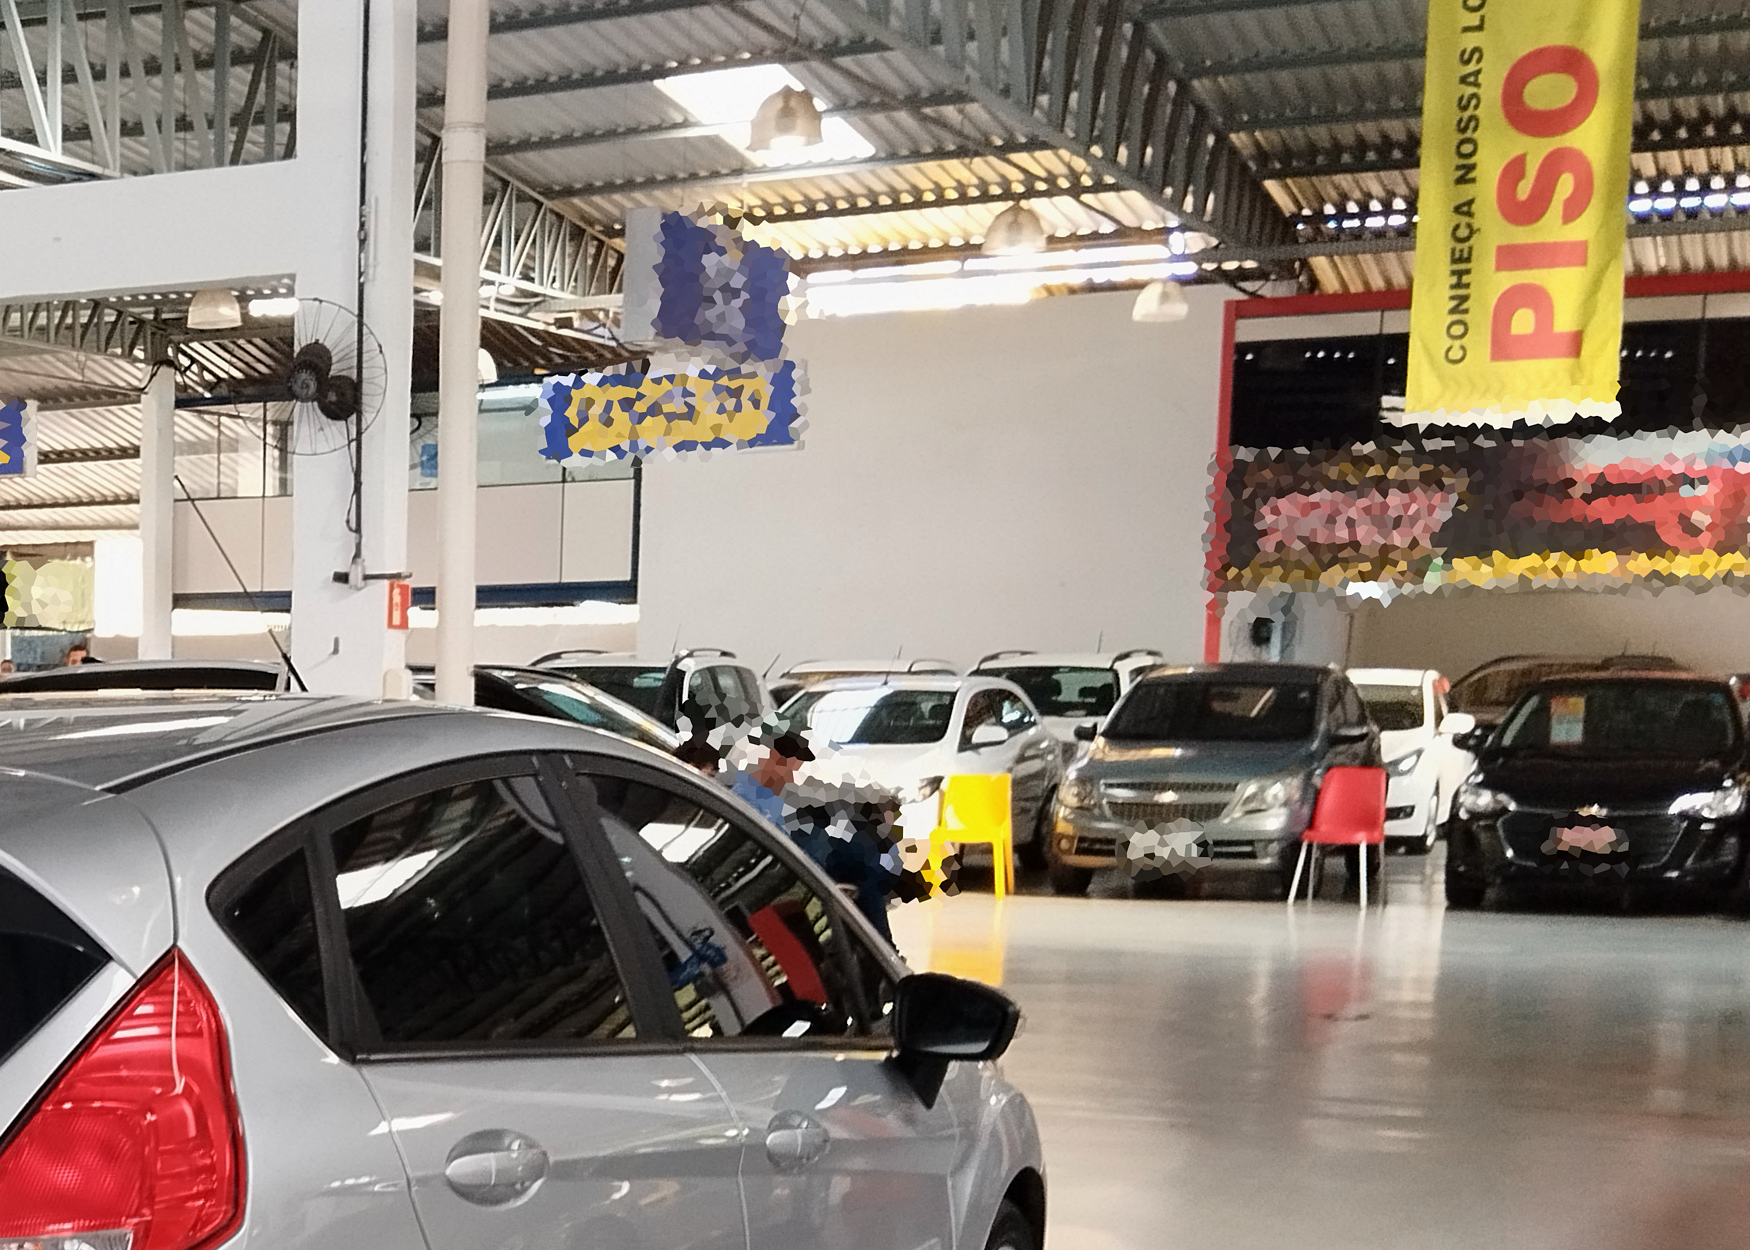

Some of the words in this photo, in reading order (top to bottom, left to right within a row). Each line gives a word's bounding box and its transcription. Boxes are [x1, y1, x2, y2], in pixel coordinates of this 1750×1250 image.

[1453, 46, 1484, 186] NOSSAS
[1444, 198, 1481, 365] CONHEÇA
[1490, 44, 1599, 362] PISO
